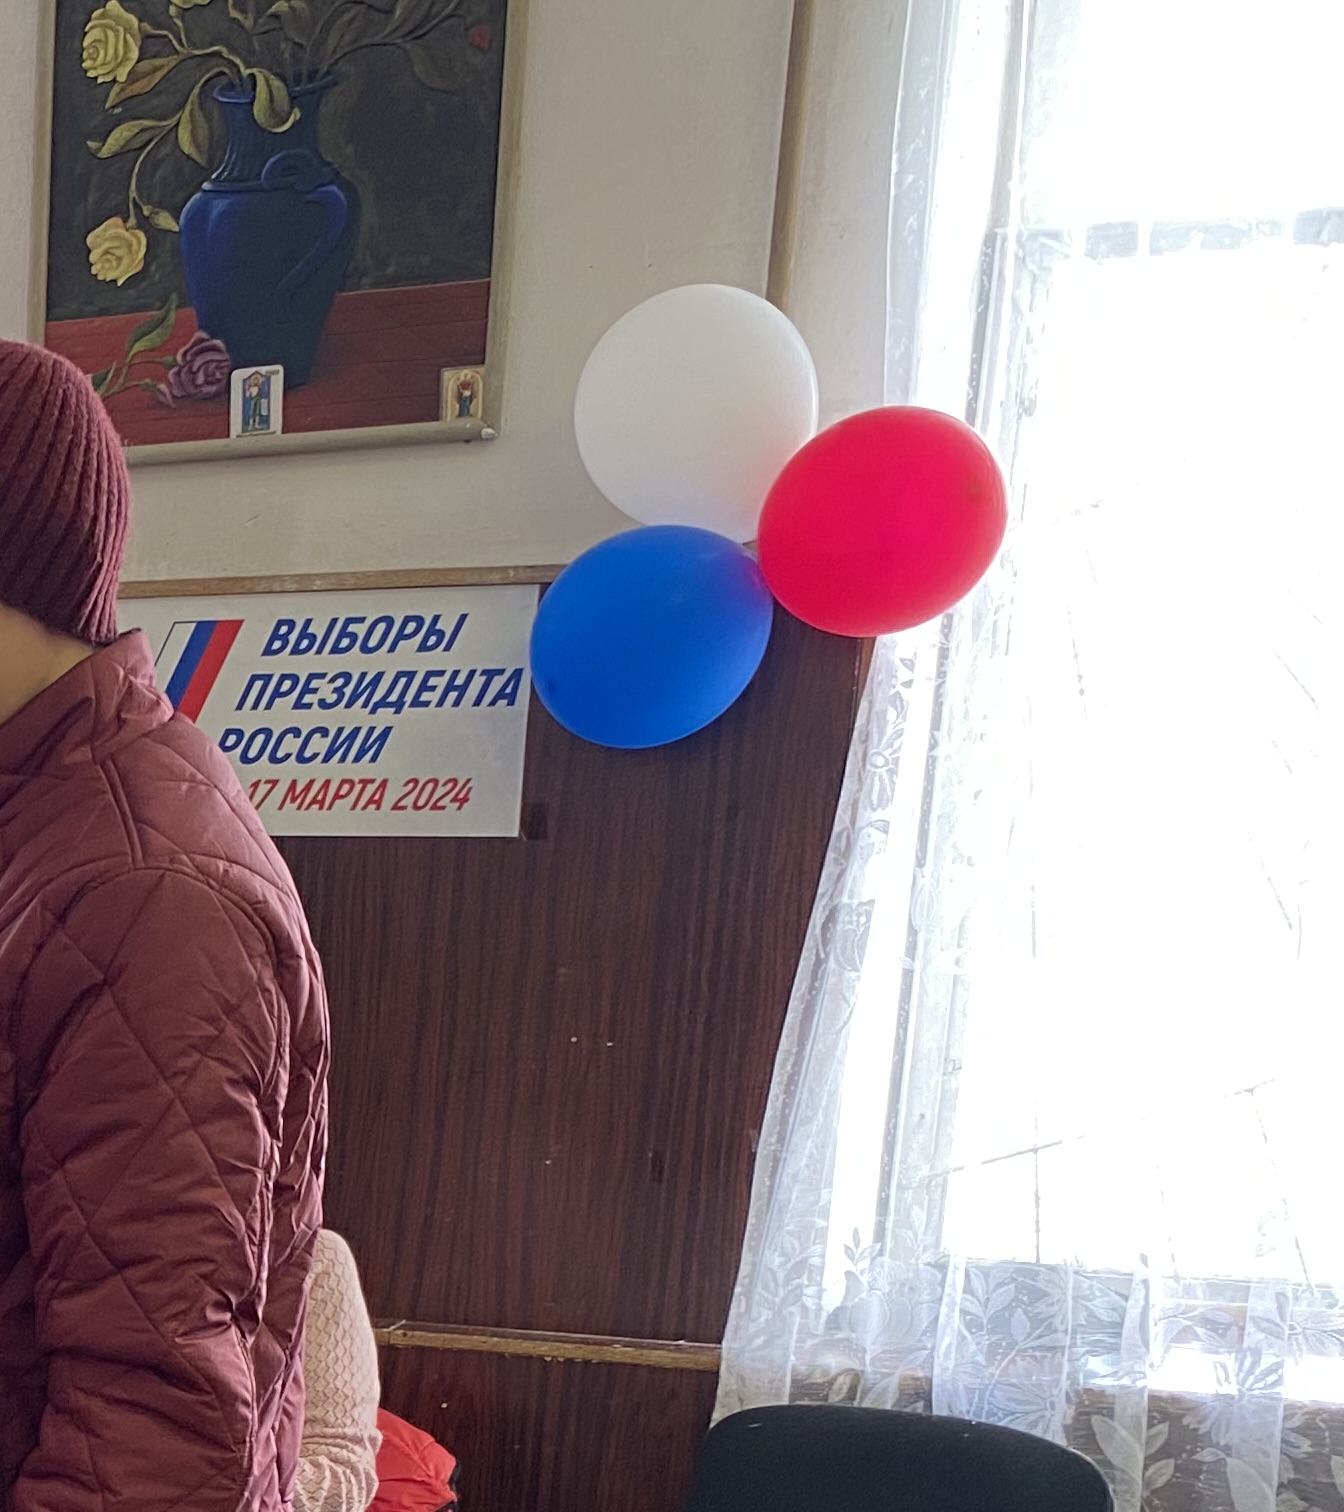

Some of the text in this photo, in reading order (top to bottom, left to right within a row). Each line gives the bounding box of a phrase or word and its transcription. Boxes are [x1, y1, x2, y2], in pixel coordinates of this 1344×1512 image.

[260, 612, 470, 658] ВЫБОРЫ
[234, 667, 524, 715] ПРЕЗИДЕНТА
[218, 725, 394, 765] РОССИИ
[277, 777, 389, 811] МАРТА
[389, 777, 474, 811] 2024
